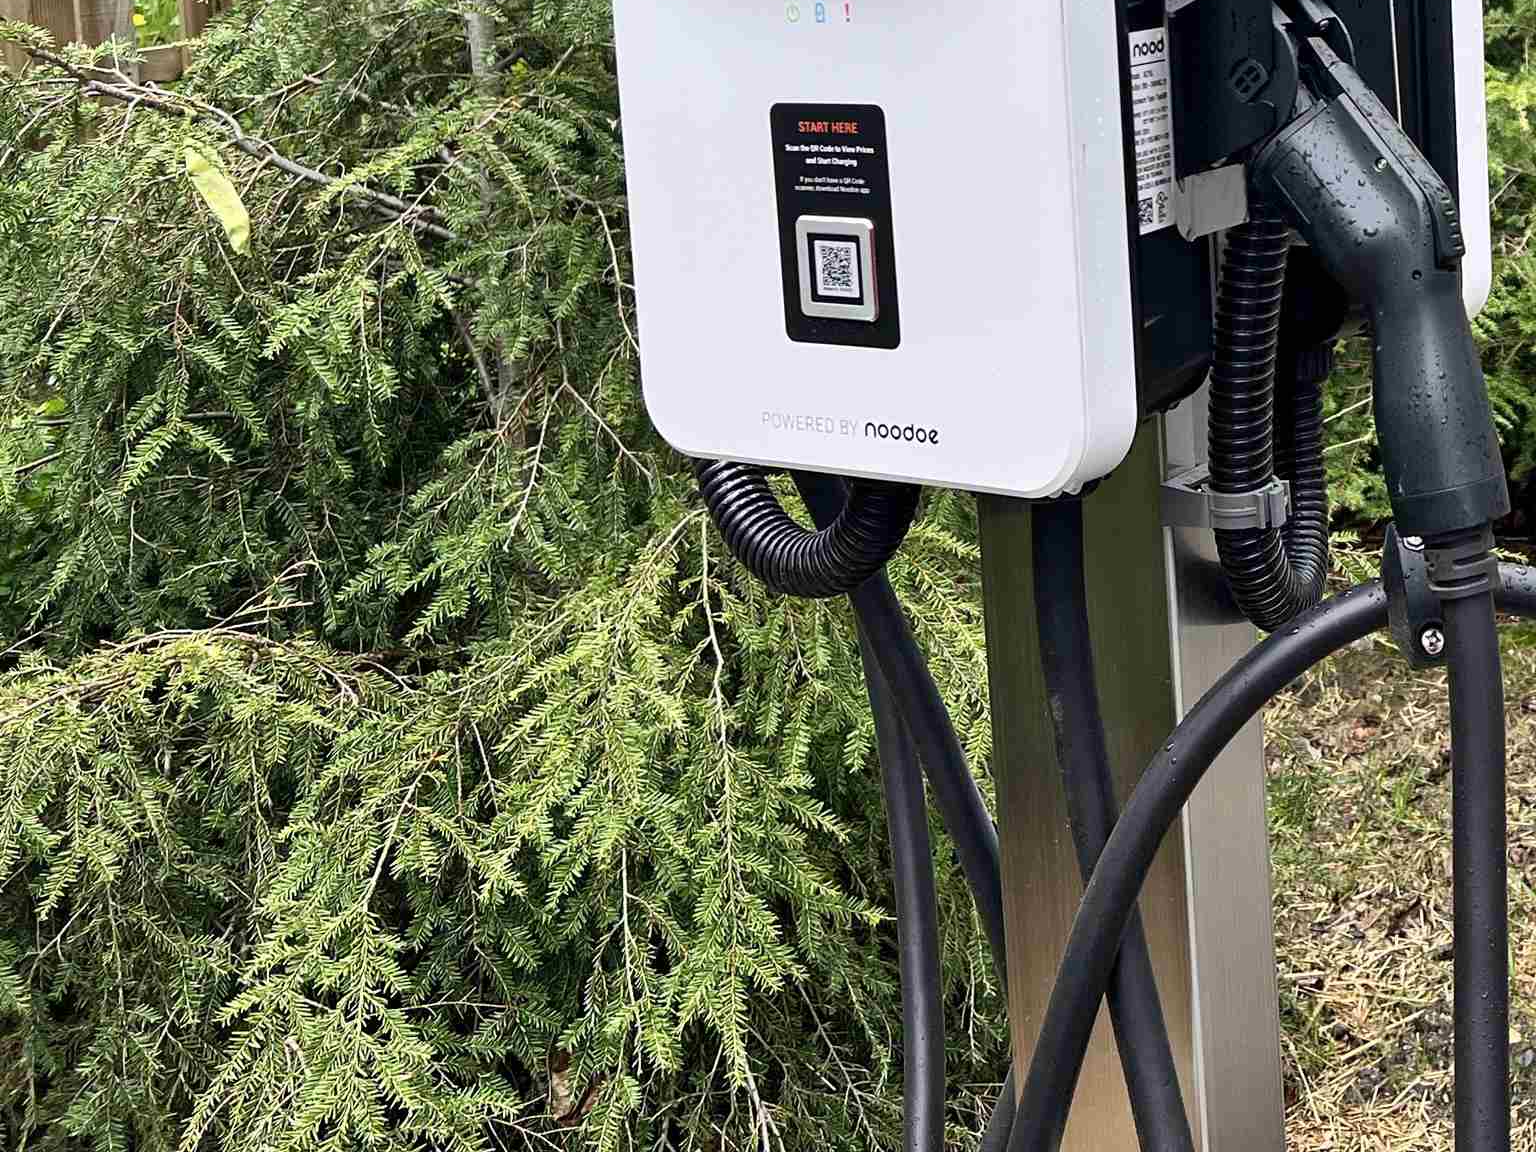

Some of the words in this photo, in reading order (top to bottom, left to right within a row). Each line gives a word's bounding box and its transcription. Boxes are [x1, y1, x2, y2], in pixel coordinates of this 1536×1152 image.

[798, 121, 829, 134] START
[831, 121, 859, 135] HERE
[819, 145, 834, 153] Code
[761, 411, 835, 435] POWERED
[839, 419, 859, 436] BY
[865, 421, 939, 445] noodoe
